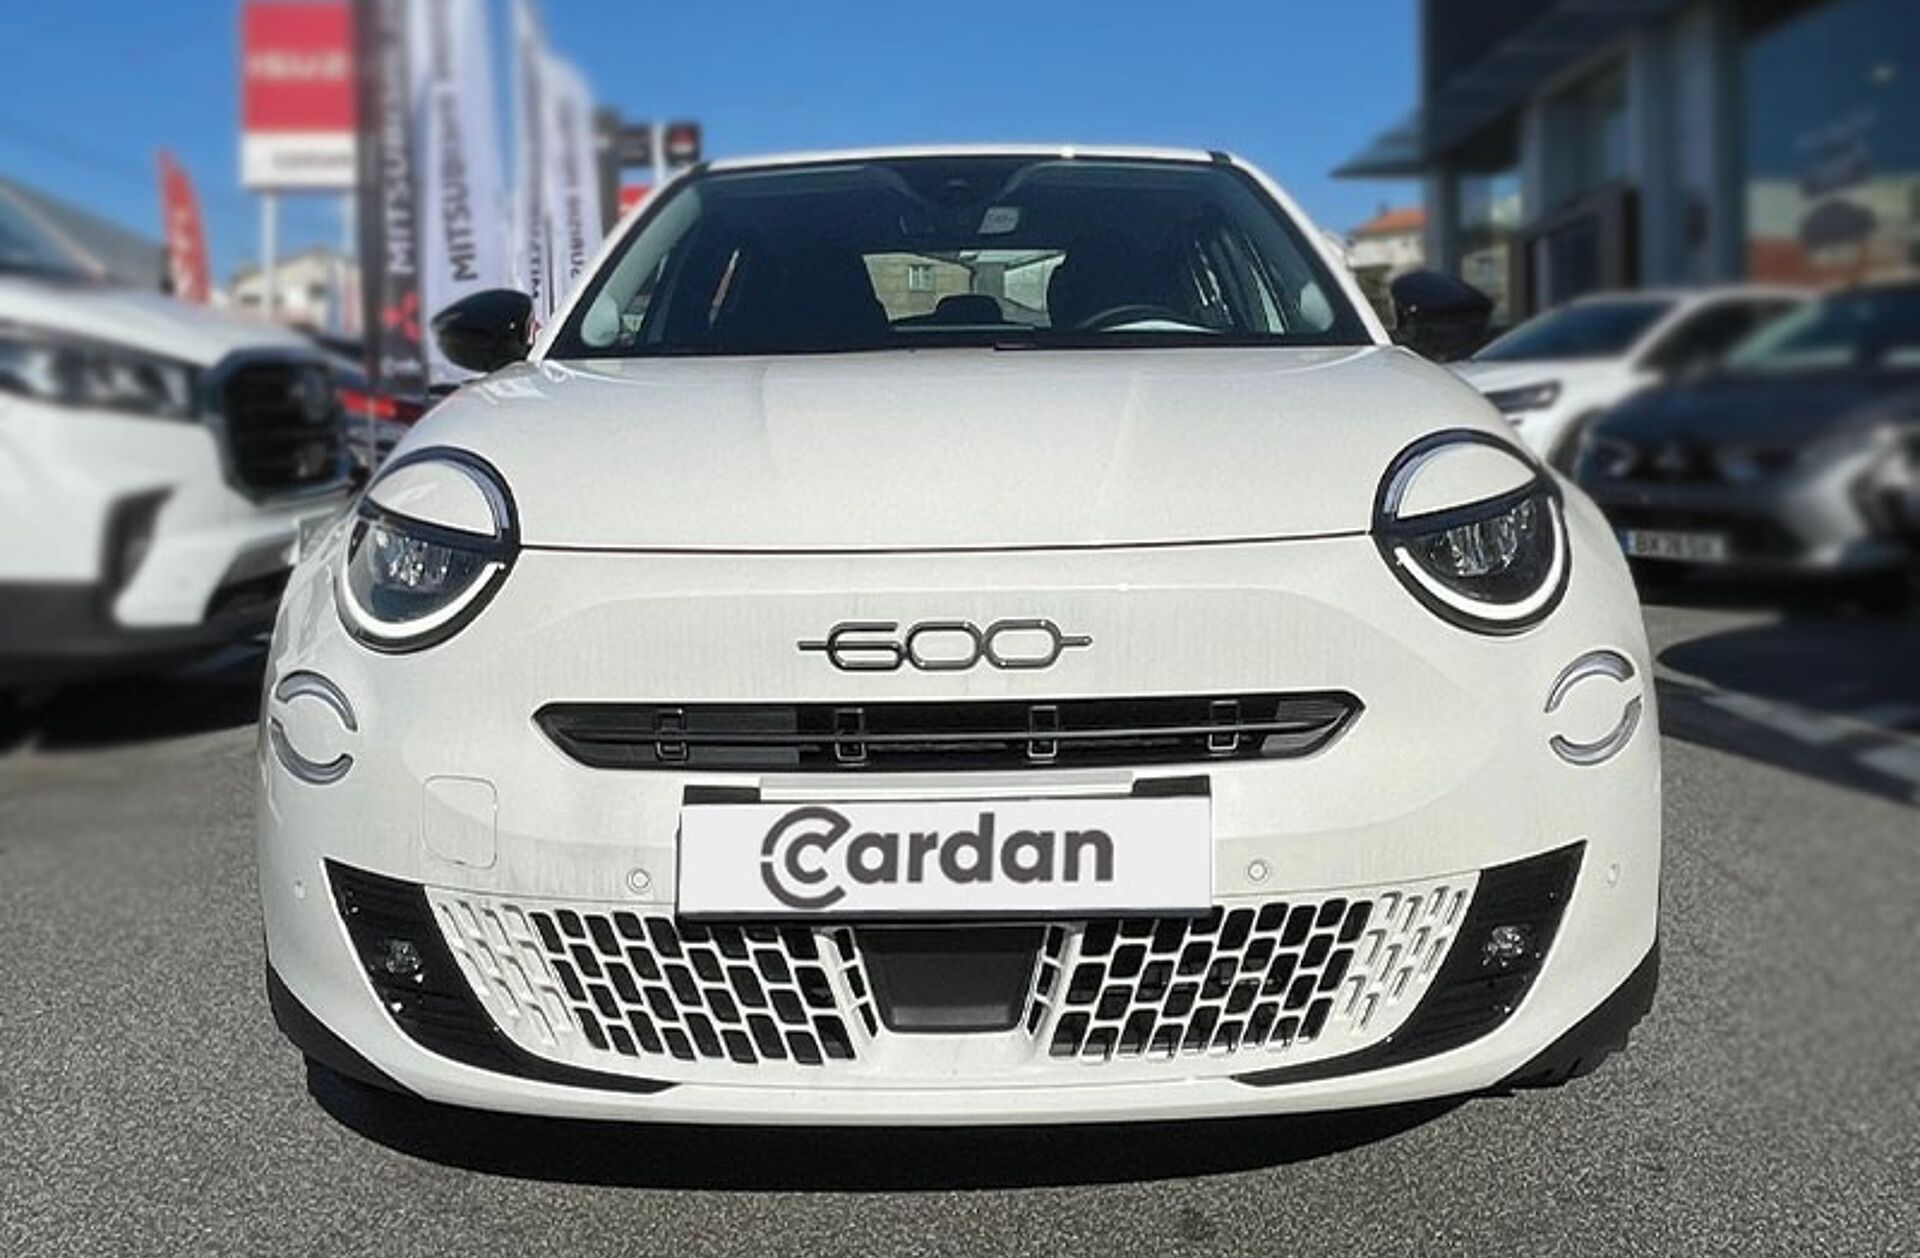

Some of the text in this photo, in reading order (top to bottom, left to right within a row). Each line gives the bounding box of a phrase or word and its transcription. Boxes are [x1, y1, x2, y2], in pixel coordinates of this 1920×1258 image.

[437, 92, 479, 281] MITSUB
[827, 619, 1062, 671] 600
[760, 806, 1115, 910] Cardan
